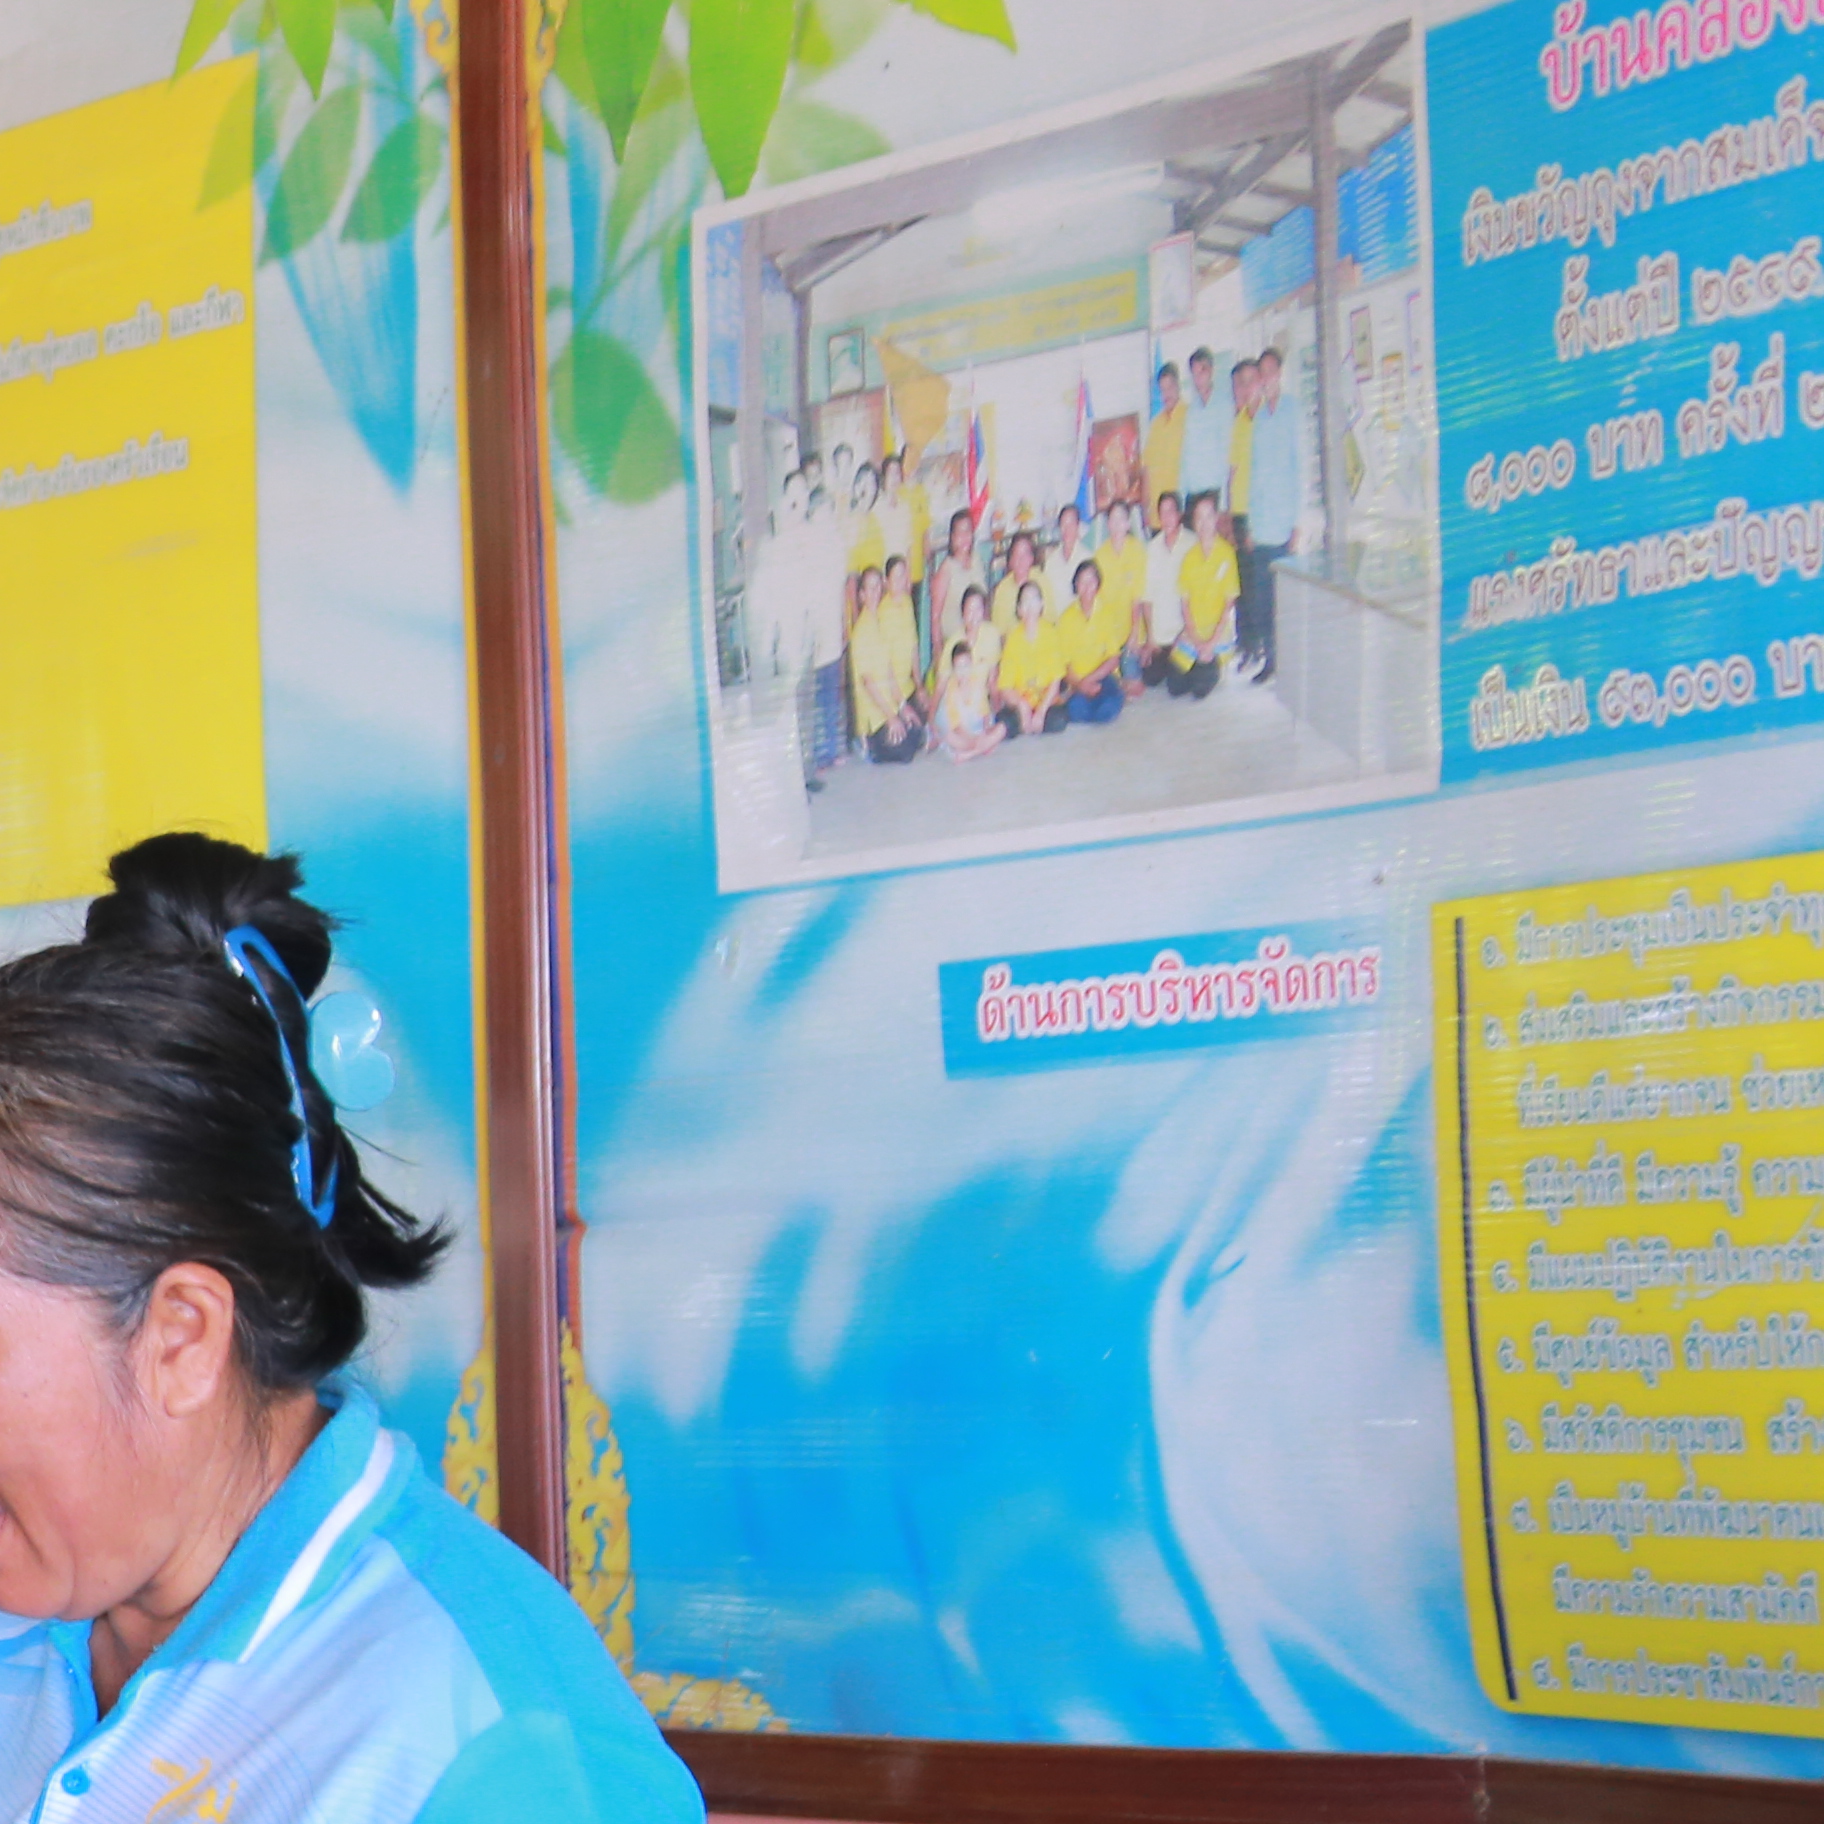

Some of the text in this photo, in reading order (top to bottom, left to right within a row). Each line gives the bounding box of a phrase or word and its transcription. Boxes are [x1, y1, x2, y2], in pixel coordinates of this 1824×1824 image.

[1555, 252, 1680, 362] ตั้งแต่ปี
[1586, 409, 1664, 480] บาท
[1677, 332, 1785, 458] ครั้งที่
[1471, 664, 1591, 751] เป็นเงิน
[978, 937, 1382, 1042] ด้านการบริหารจัดการ
[1637, 1143, 1744, 1218] มีความรู้
[1532, 1316, 1674, 1389] มีศูนย์ข้อมูล
[1541, 1400, 1746, 1472] มีสวัสดิการชุมชน
